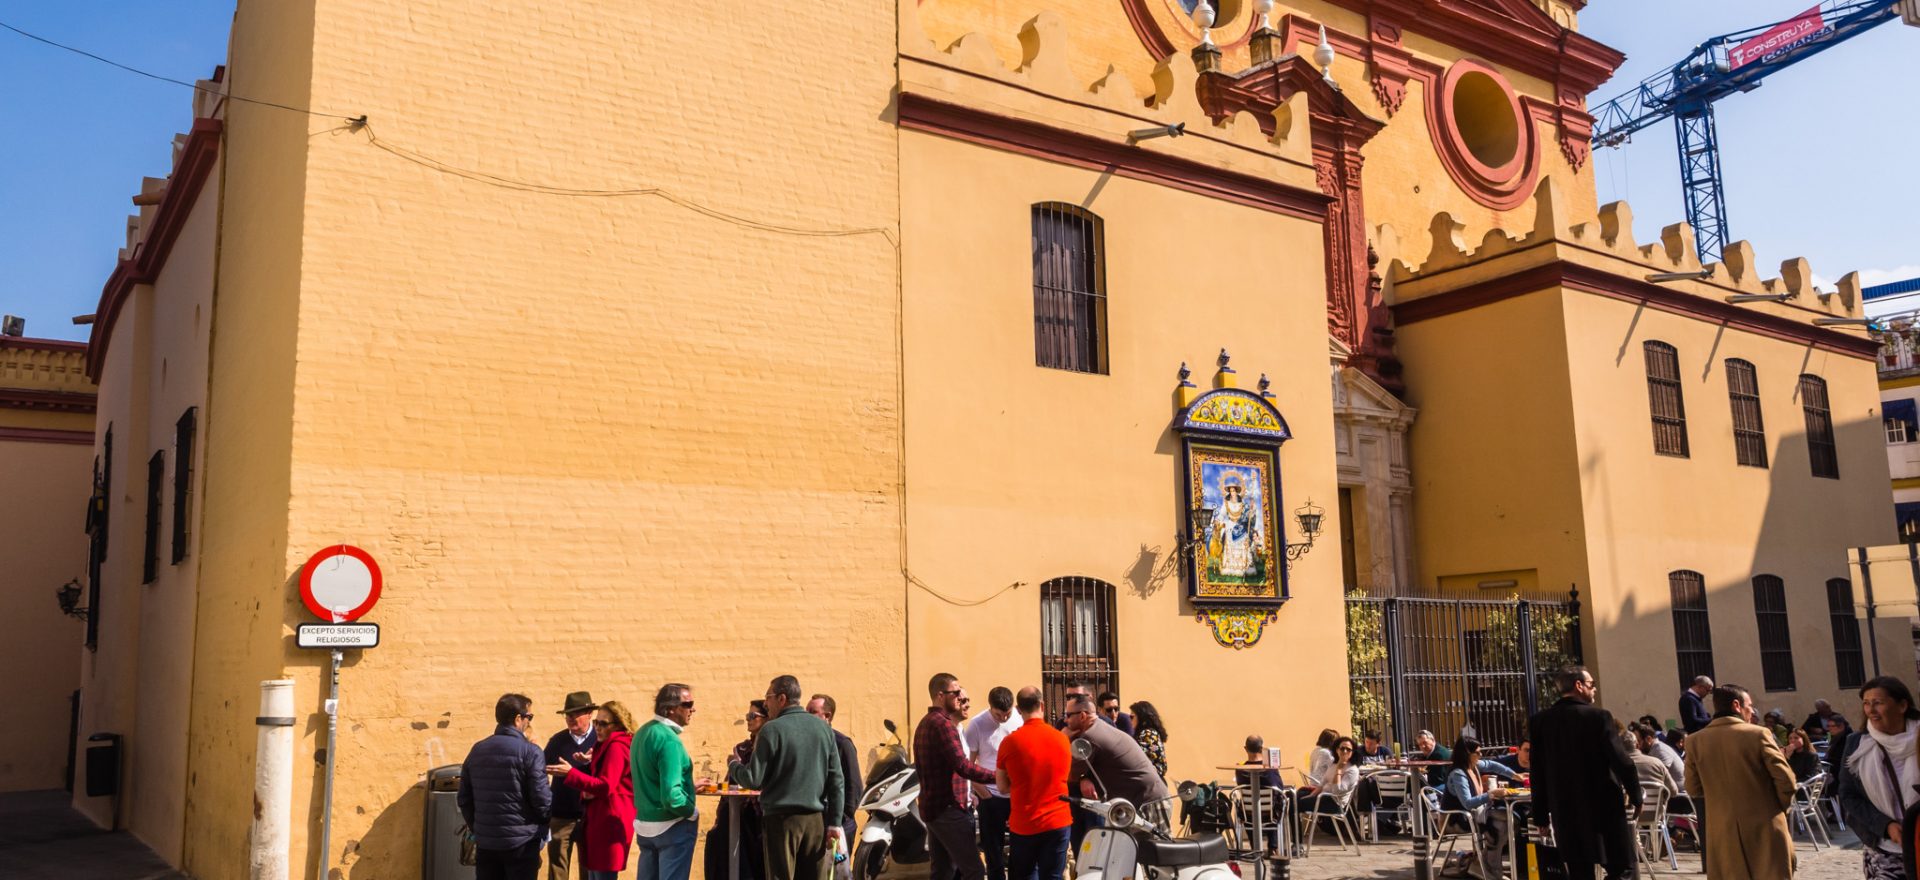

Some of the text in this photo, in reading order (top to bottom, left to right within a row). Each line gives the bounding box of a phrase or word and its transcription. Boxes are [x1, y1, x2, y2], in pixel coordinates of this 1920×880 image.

[1746, 20, 1813, 58] CONSTRUYA
[302, 627, 376, 635] EXCEPTO SERVICIOS
[316, 636, 361, 644] RELIGIOSOS
